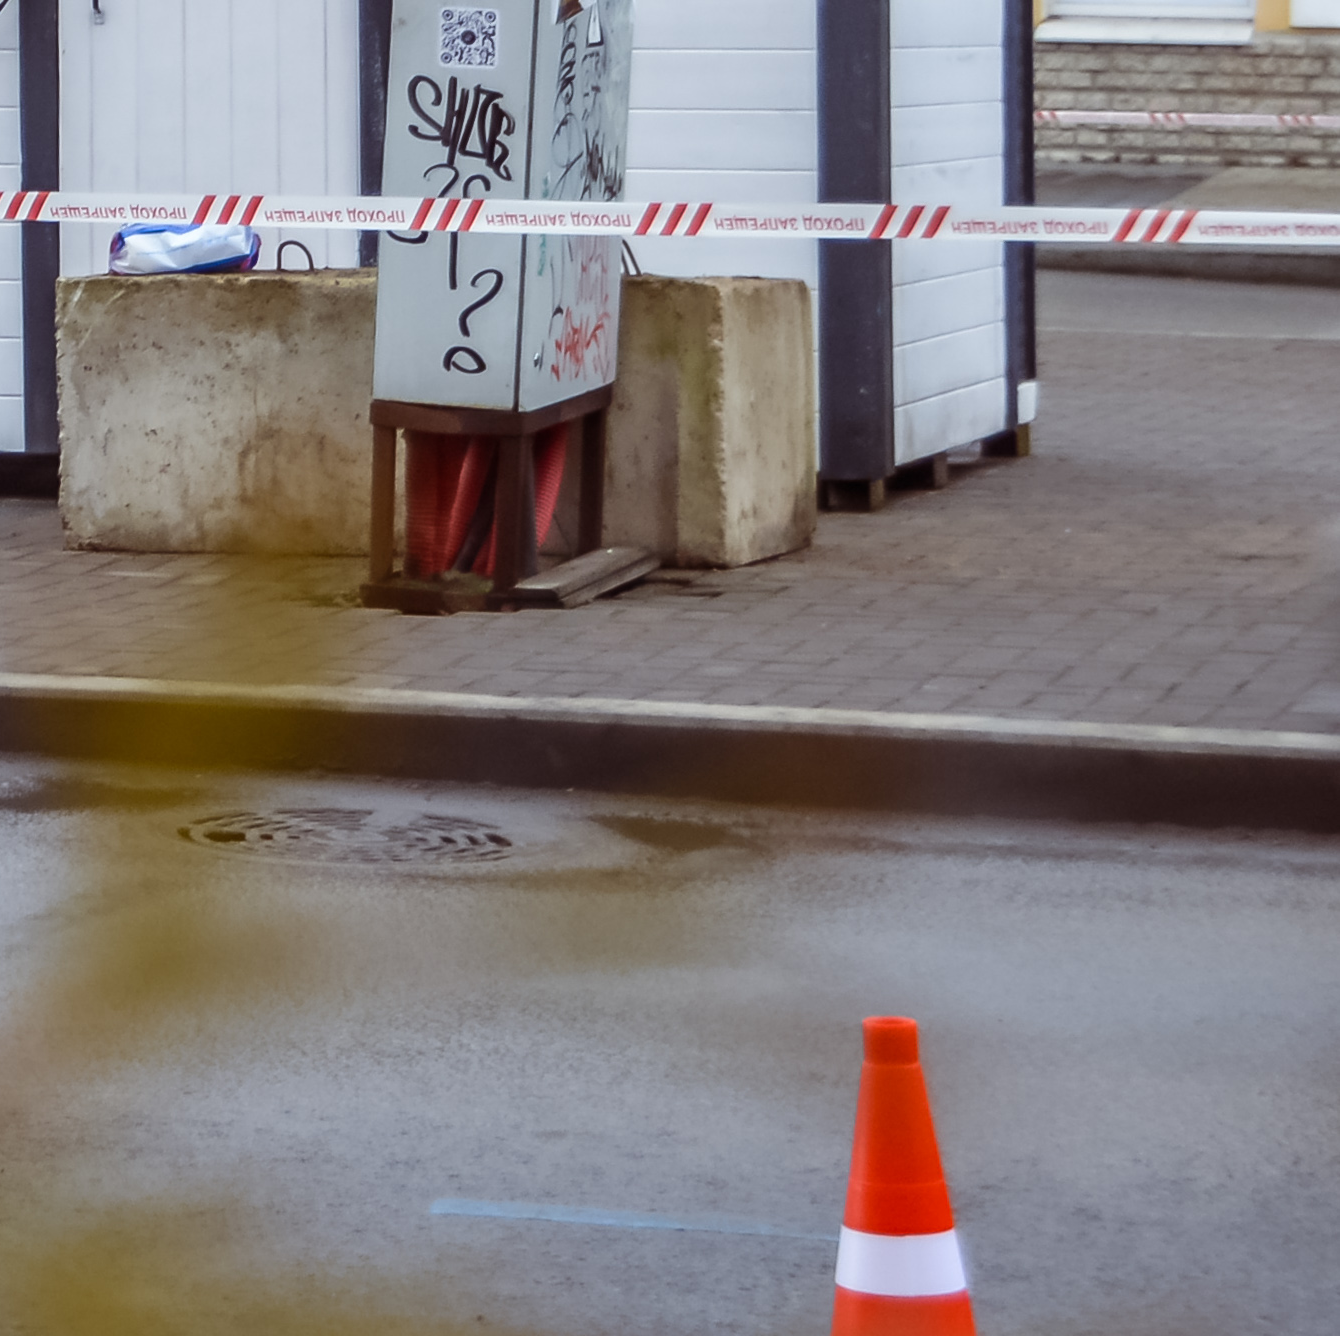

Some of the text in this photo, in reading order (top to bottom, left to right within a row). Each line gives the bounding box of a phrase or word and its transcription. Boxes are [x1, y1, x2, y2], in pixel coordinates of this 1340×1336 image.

[49, 204, 188, 220] ПРОХОД ЗАПРЕЩЕН
[264, 207, 405, 223] ПРОХОД ЗАПРЕЩЕН
[485, 212, 631, 227] ПРОХОД ЗАПРЕЩЕН
[714, 215, 866, 231] ПРОХОД ЗАПРЕЩЕН
[951, 219, 1109, 235] ПРОХОД ЗАПРЕЩЕН
[1198, 223, 1289, 236] ЗАПРЕЩЕН
